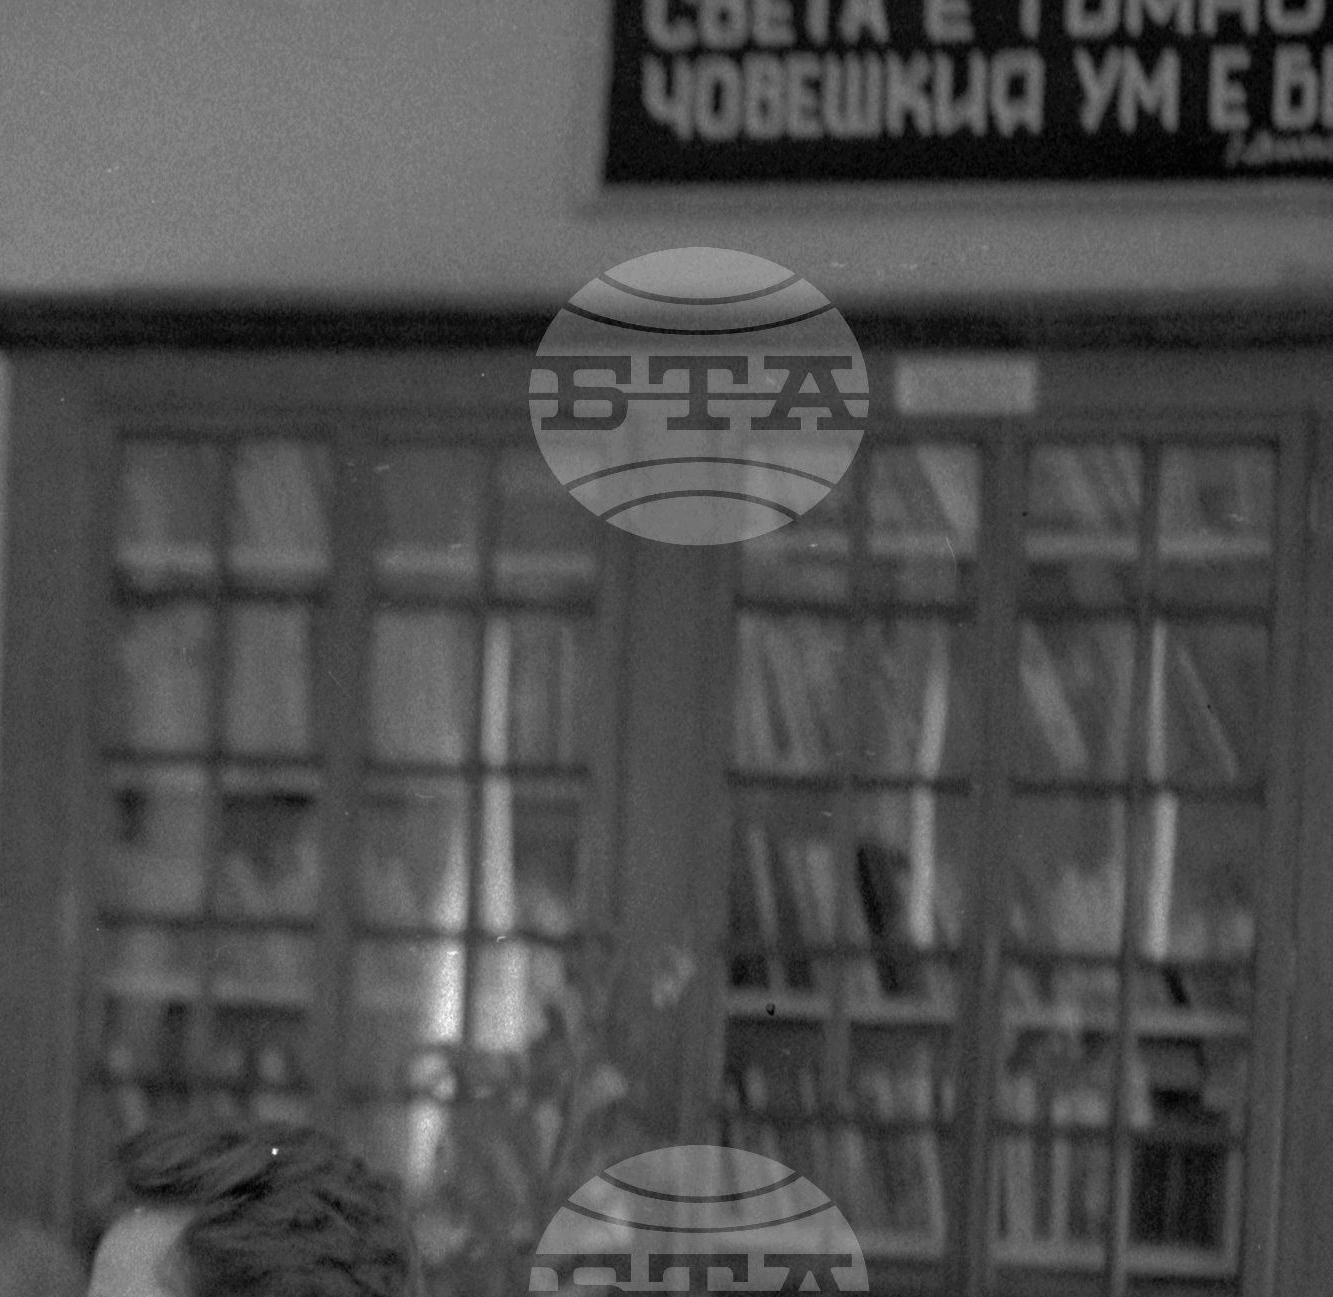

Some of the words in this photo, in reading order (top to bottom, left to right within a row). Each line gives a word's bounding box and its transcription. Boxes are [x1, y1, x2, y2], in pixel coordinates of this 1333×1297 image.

[641, 48, 1046, 140] ЧОВЕШКИЯ
[1073, 45, 1181, 134] УМ
[1208, 43, 1252, 132] Е
[1271, 42, 1333, 131] Б
